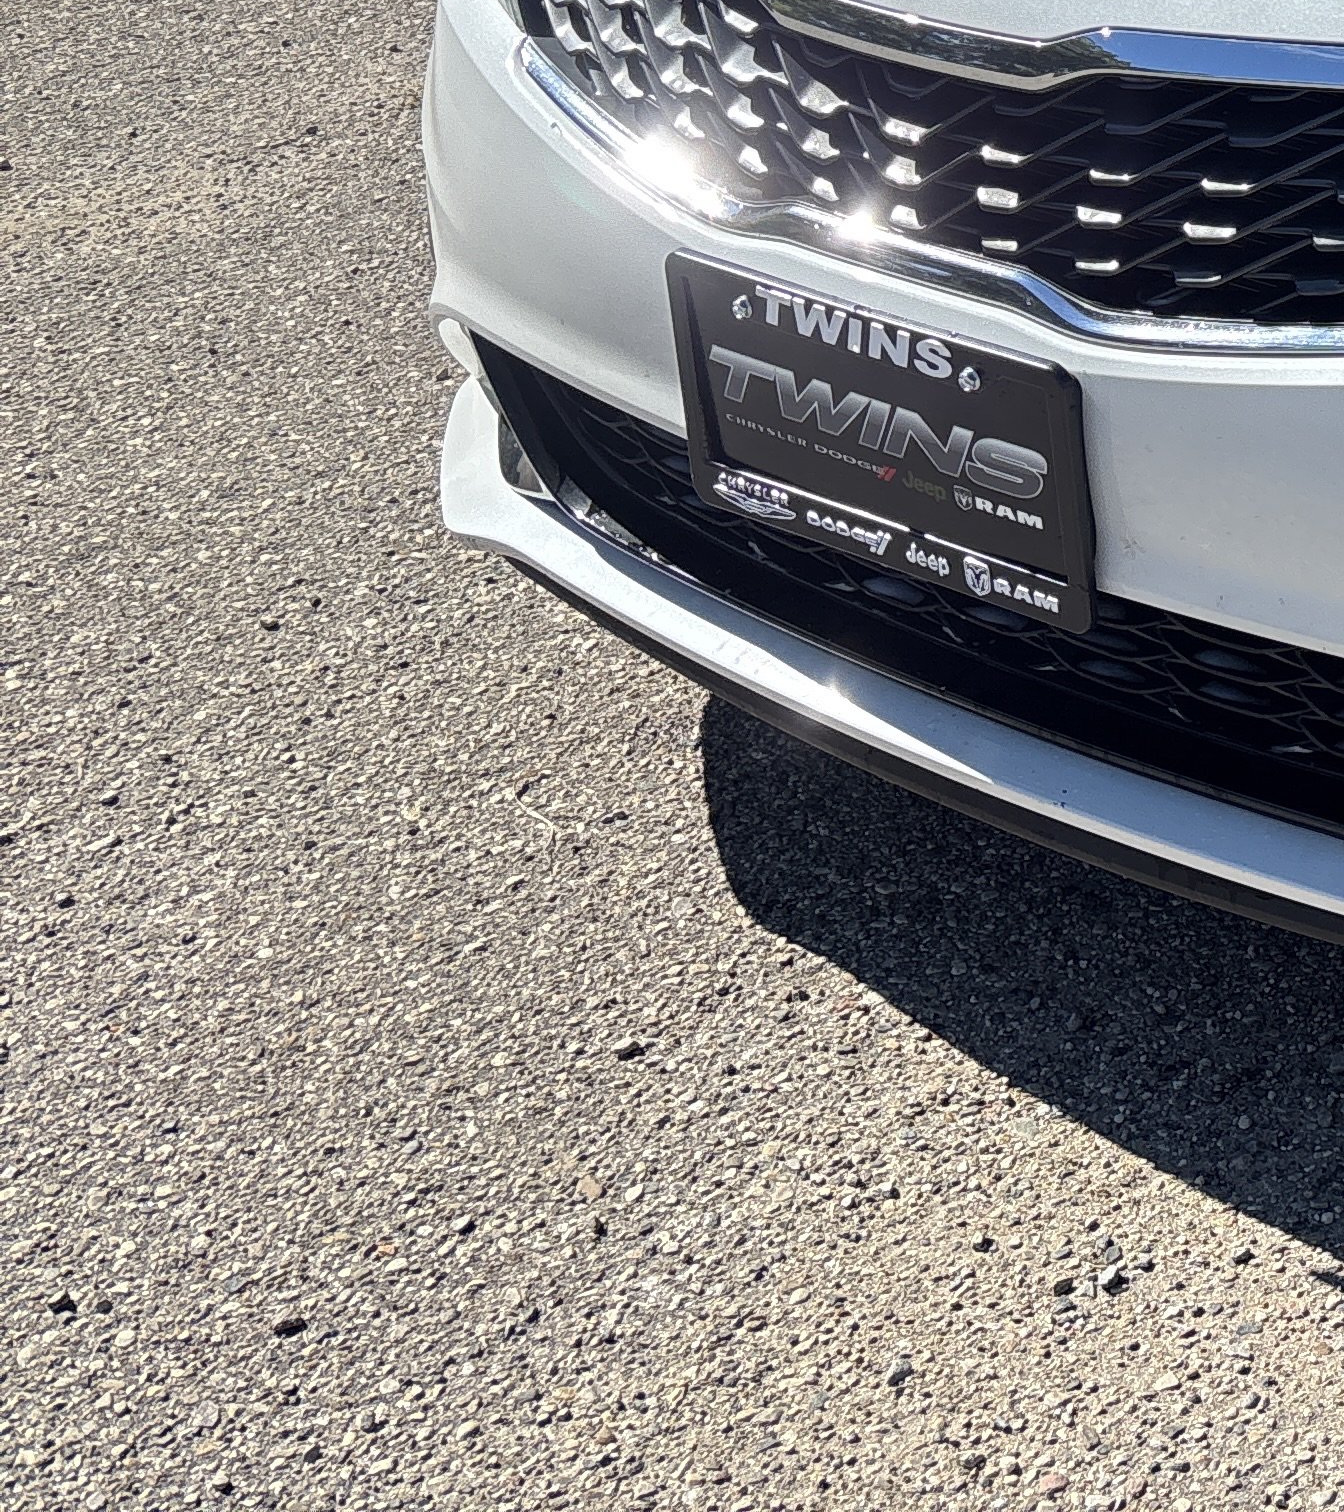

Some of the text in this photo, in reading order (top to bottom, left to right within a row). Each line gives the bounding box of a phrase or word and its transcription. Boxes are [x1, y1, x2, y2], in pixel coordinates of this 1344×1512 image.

[755, 285, 953, 379] TWINS
[708, 344, 1049, 499] TWINS
[726, 413, 1044, 530] CHRYSLER DODGE Jeep RAM
[718, 472, 1060, 614] CHRYSLER DODGE Jeep RAM
